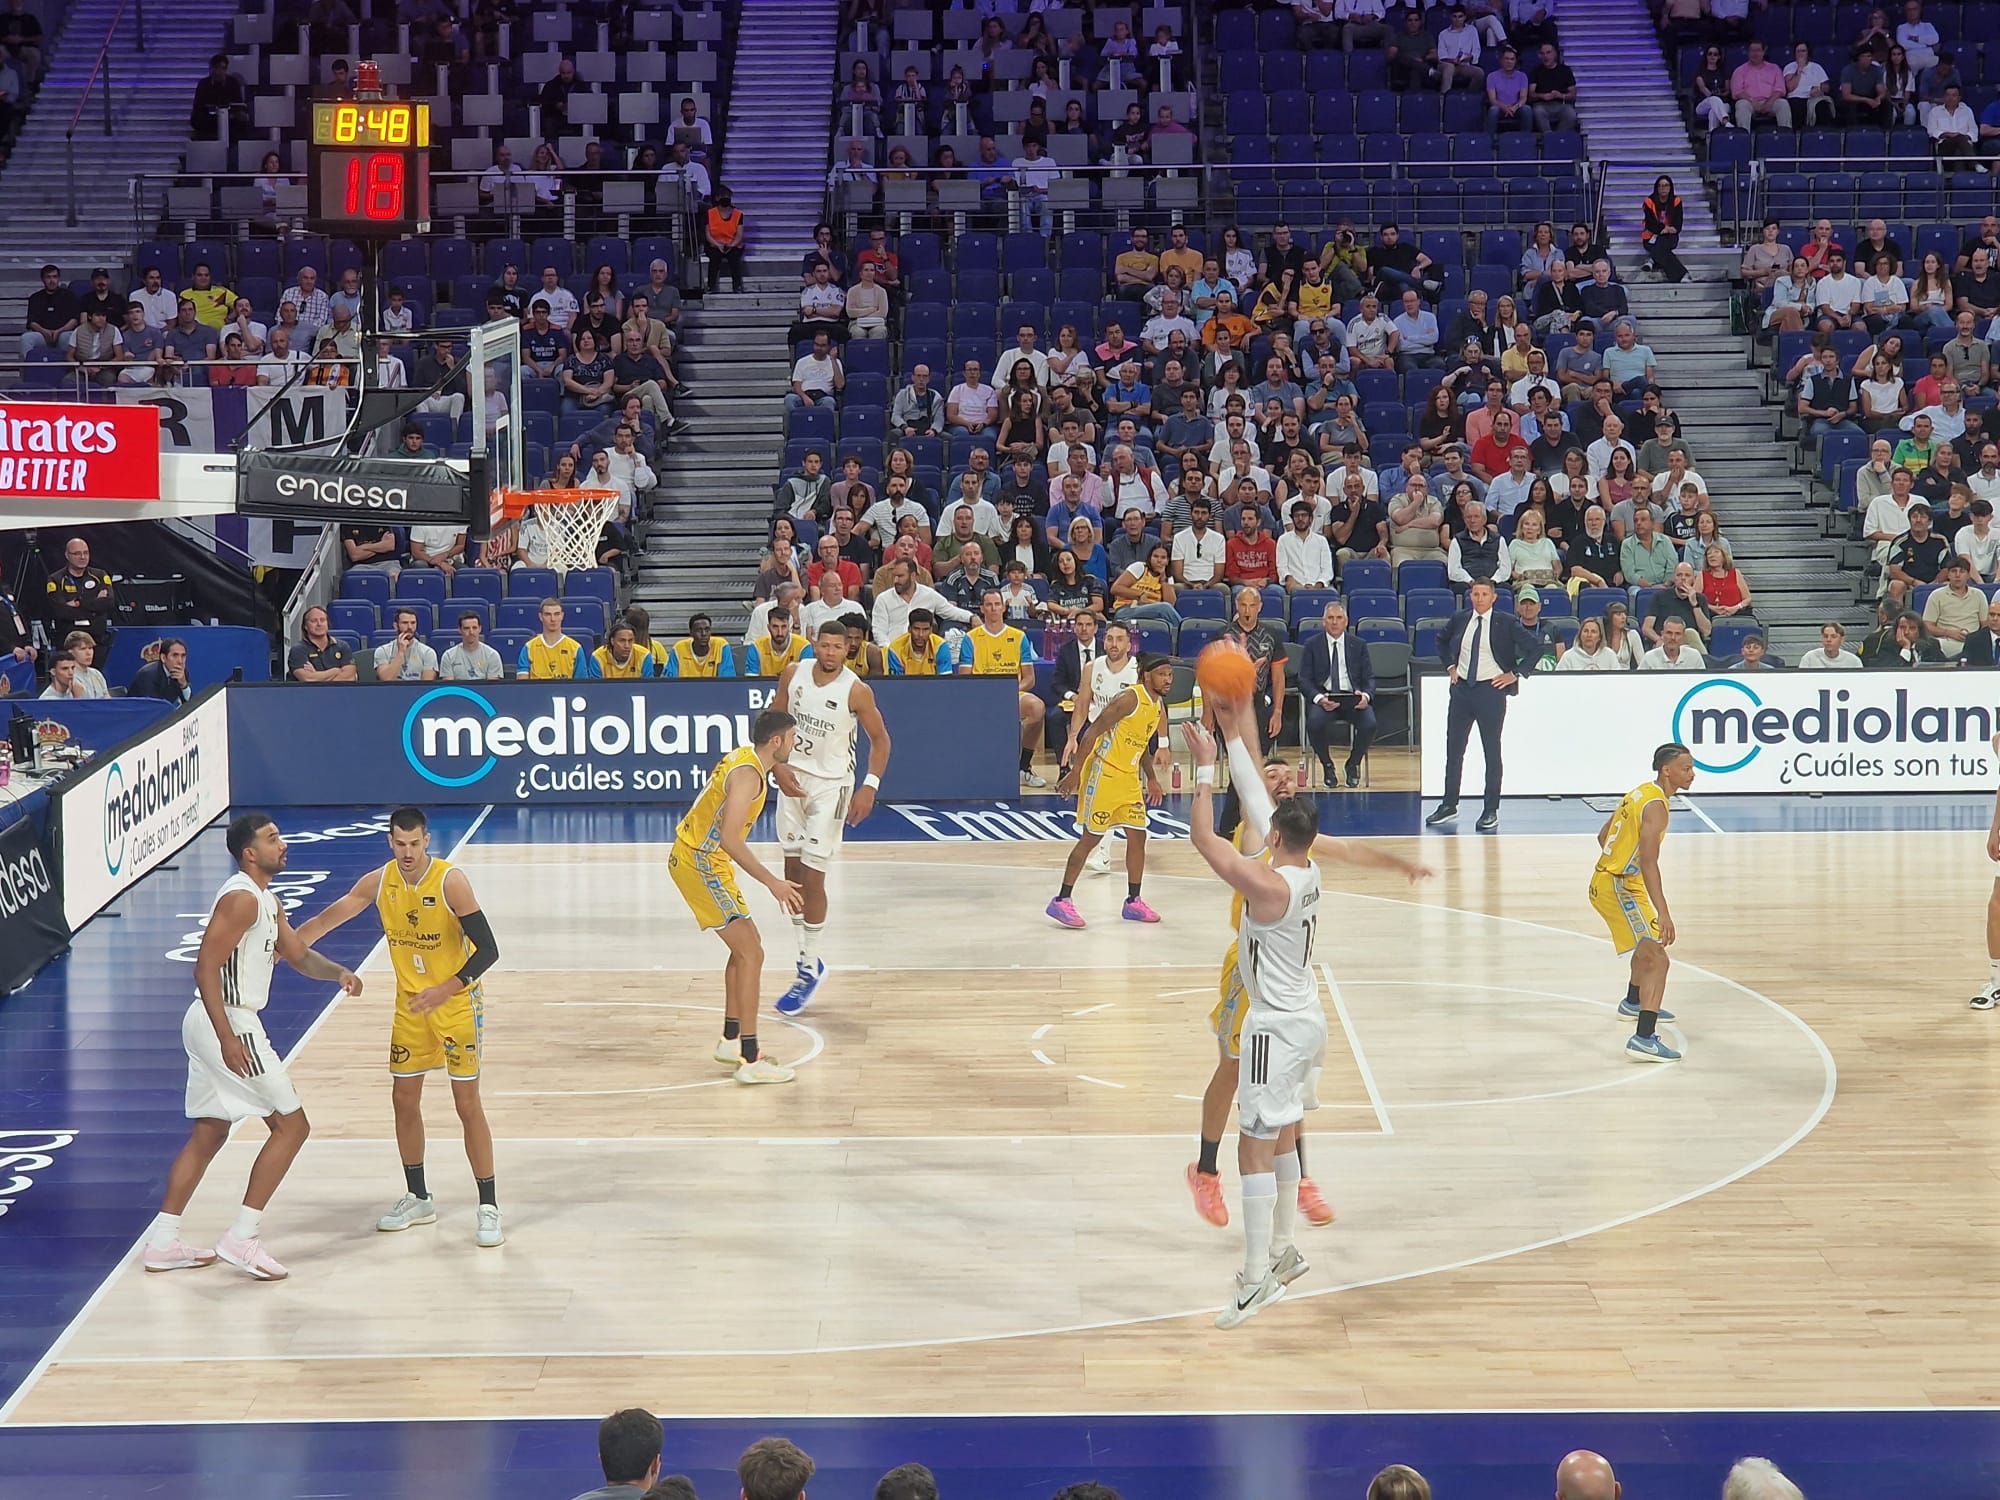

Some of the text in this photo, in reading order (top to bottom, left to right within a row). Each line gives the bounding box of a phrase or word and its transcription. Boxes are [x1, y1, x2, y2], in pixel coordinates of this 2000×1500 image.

[336, 108, 410, 143] 8:48
[346, 153, 404, 220] 18
[270, 395, 325, 447] M
[0, 457, 87, 491] BETTER
[276, 474, 408, 510] endesa
[182, 718, 199, 745] BANCO
[422, 696, 755, 756] mediolan
[794, 734, 814, 756] 22
[515, 762, 625, 799] ¿Cuáles
[632, 769, 682, 791] son
[1779, 752, 1988, 784] ¿Cuáles son tus
[107, 744, 200, 844] mediolanum
[157, 823, 169, 847] son
[170, 815, 180, 838] tus
[886, 802, 1192, 841] Emirs
